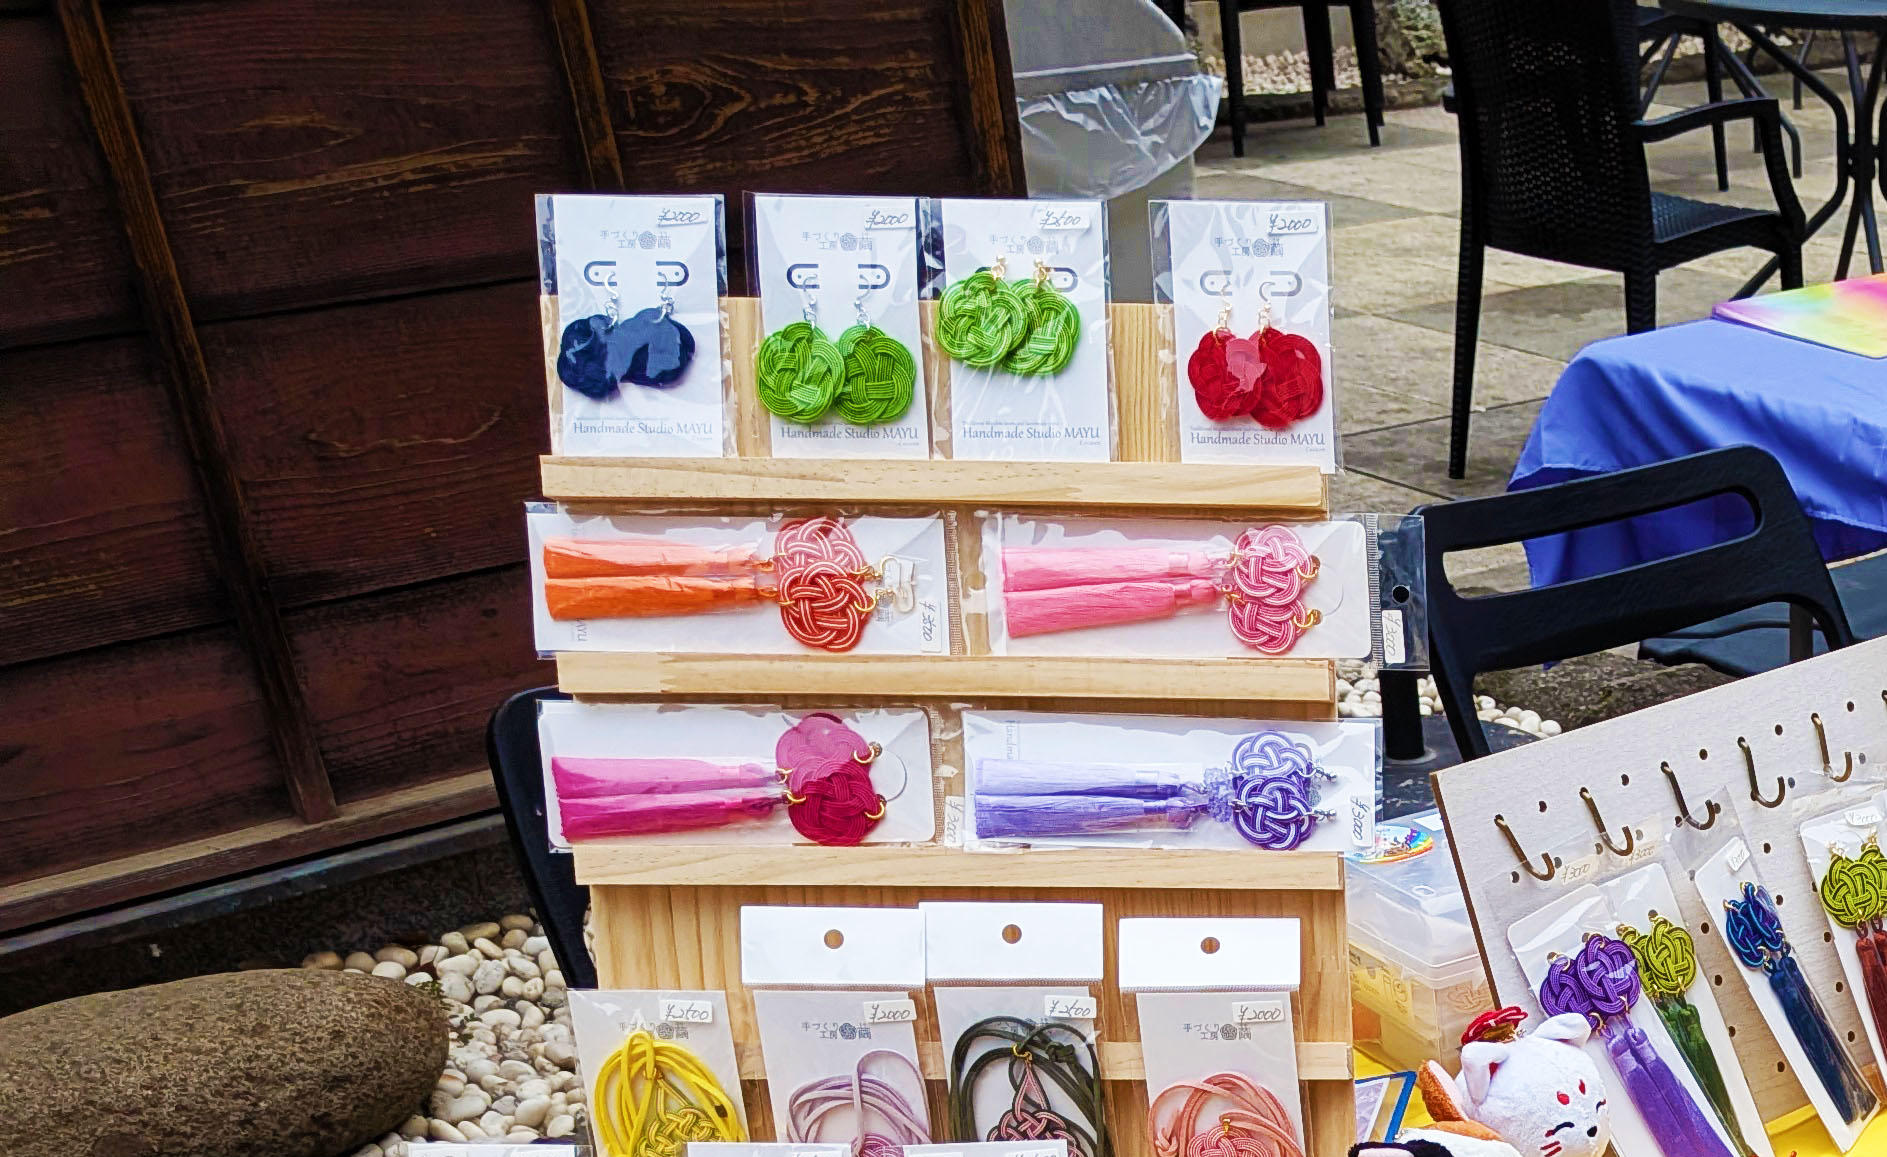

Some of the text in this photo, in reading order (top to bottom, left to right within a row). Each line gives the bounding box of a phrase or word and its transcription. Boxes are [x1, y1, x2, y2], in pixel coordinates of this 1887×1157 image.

[1269, 215, 1312, 231] ¥2000
[573, 422, 713, 435] Handmade Studio MAYU
[781, 425, 919, 439] Handmade Studio MAYU
[962, 426, 1100, 439] Handmade Studio MAYU
[1190, 432, 1325, 446] Handmade Studio MAYU
[869, 1004, 910, 1021] ¥2000
[1239, 1006, 1281, 1023] ¥2000
